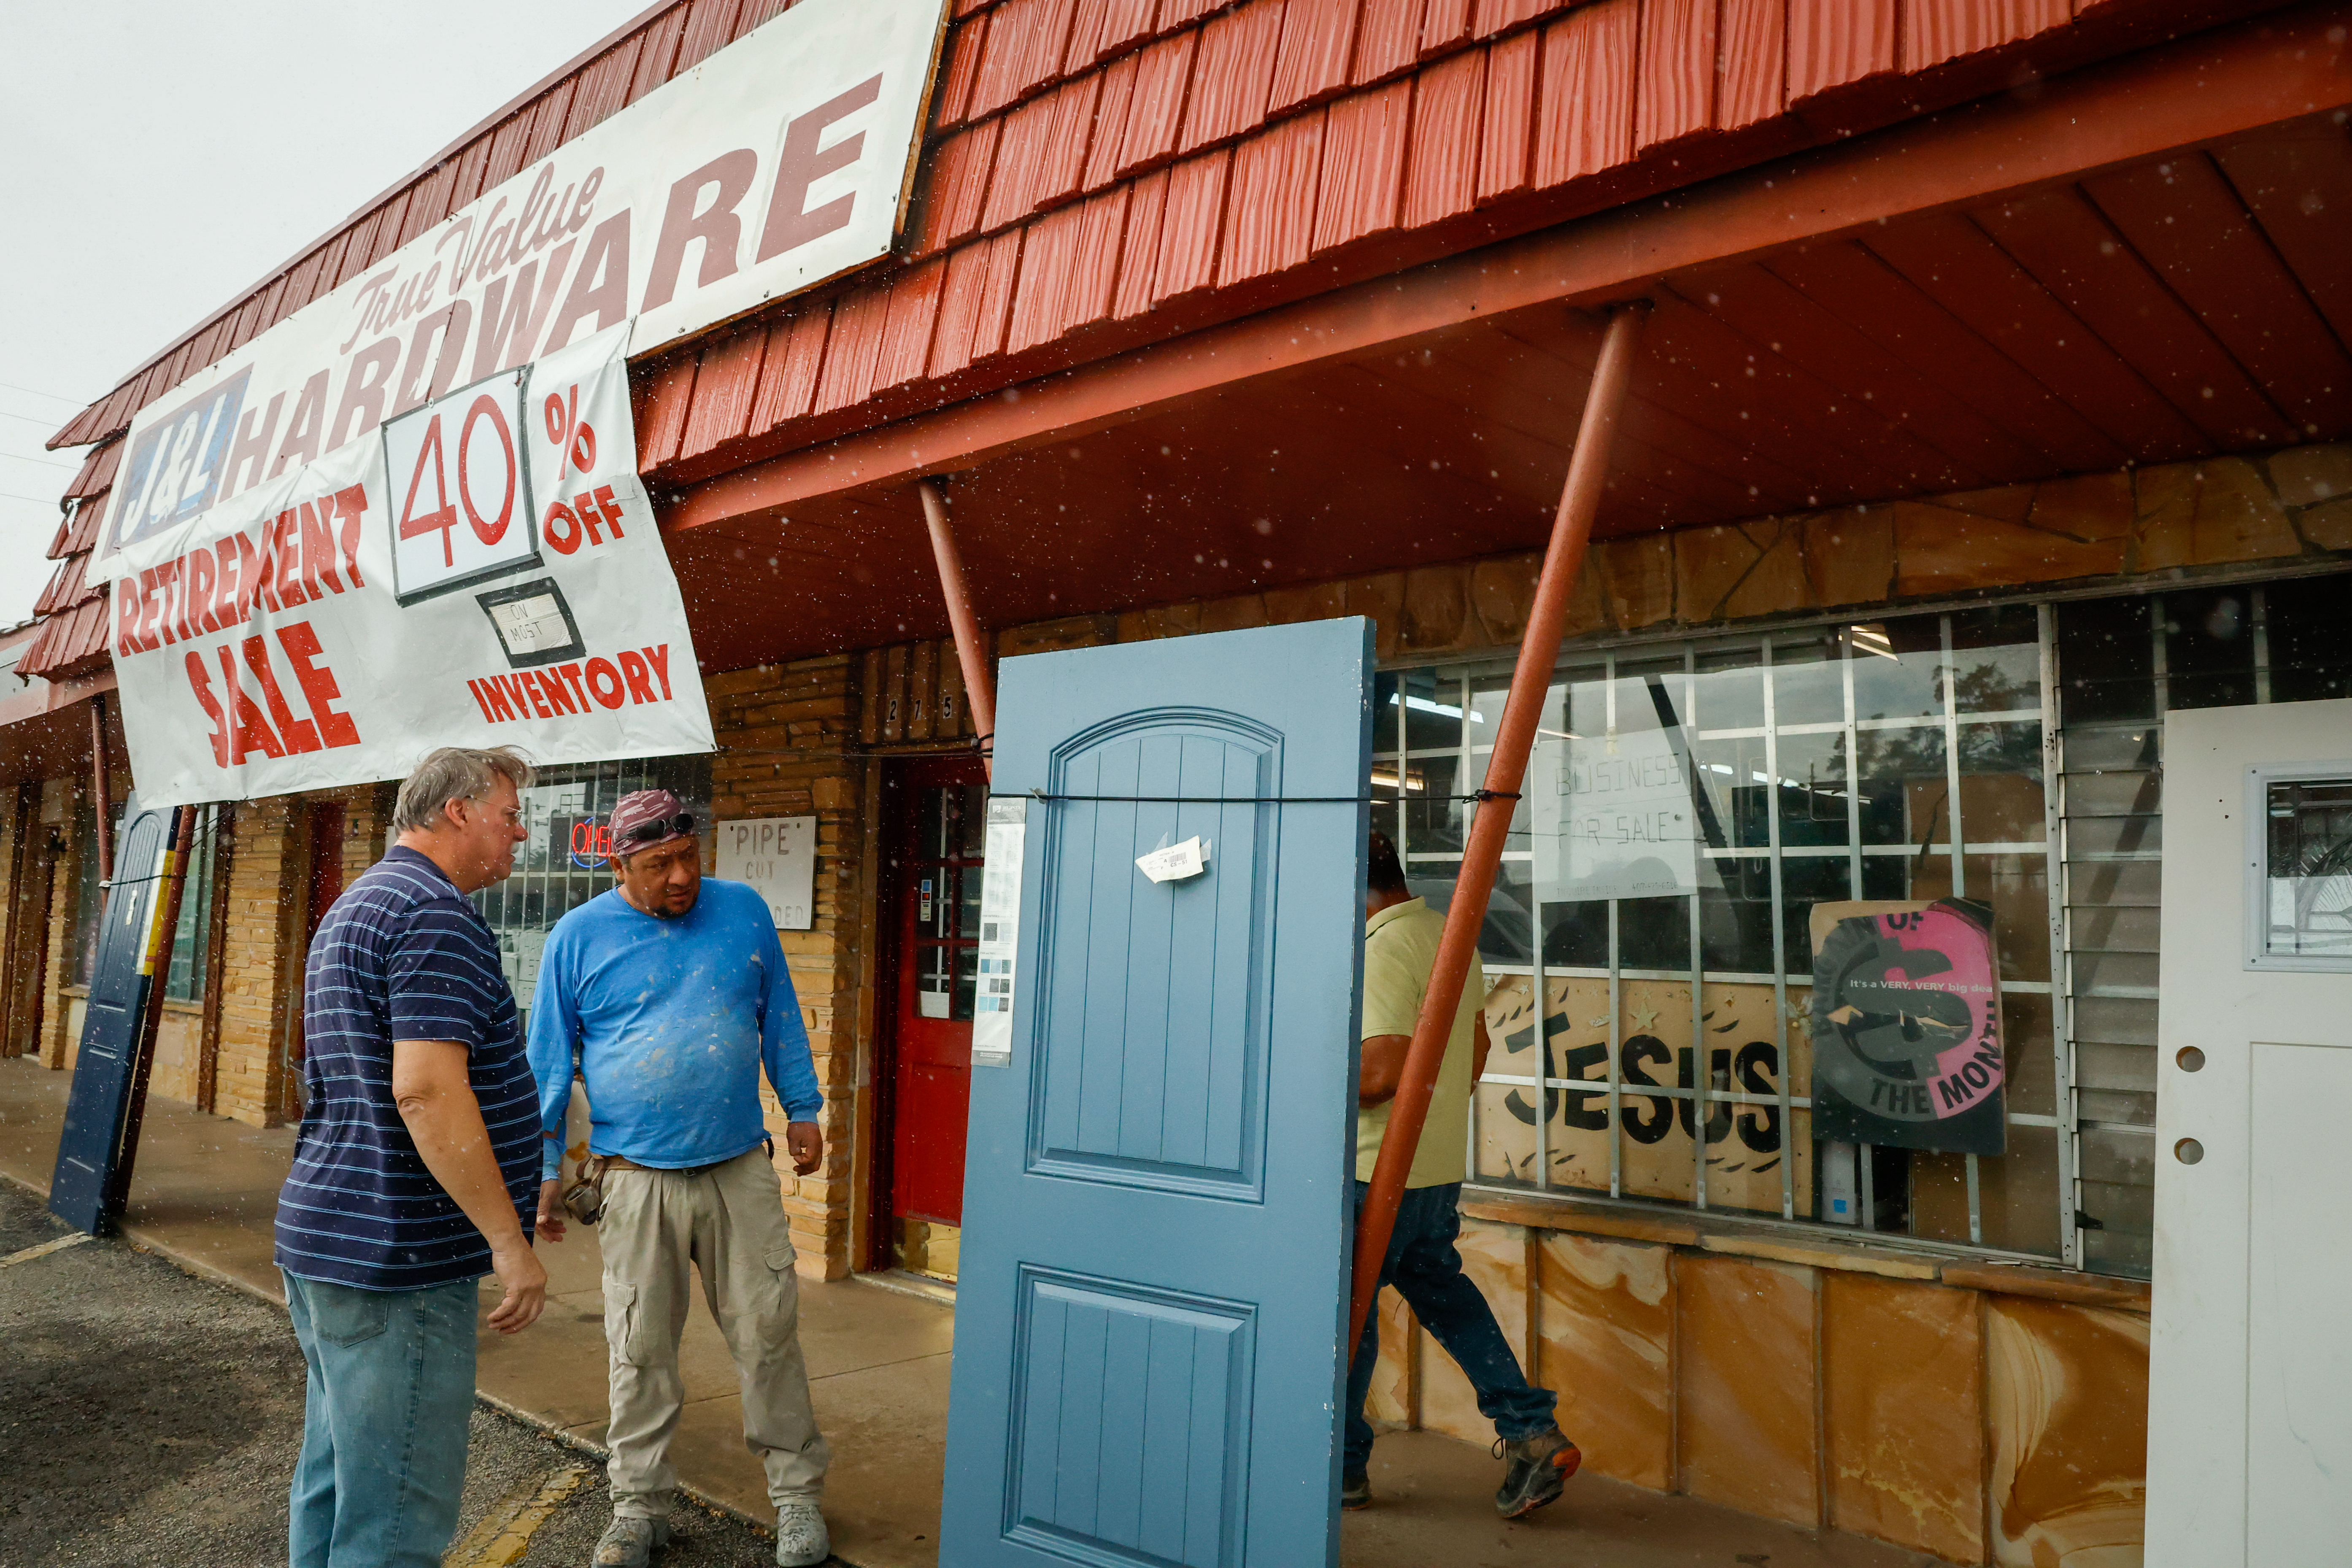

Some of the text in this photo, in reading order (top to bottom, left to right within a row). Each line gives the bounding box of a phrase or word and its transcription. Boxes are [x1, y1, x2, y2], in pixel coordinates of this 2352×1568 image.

[340, 161, 604, 355] True Value
[120, 72, 883, 542] J&L HARDWARE
[399, 383, 596, 568] 40 %
[543, 485, 625, 555] OFF
[118, 483, 367, 657] RETIREMENT
[510, 604, 528, 619] ON
[510, 621, 542, 642] MOST
[184, 621, 361, 769] SALE
[467, 644, 673, 723] INVENTORY
[1555, 753, 1680, 796] BUSINESS
[736, 823, 791, 856] PIPE
[1558, 812, 1669, 849] FOR SALE
[745, 860, 774, 880] CUT
[1850, 980, 1868, 988] It's
[1880, 980, 1912, 990] VERY,
[1915, 982, 1944, 990] VERY
[1948, 982, 1967, 993] big
[1971, 983, 1993, 993] dea
[1504, 1012, 1781, 1153] JESUS
[1869, 1077, 1930, 1114] THE
